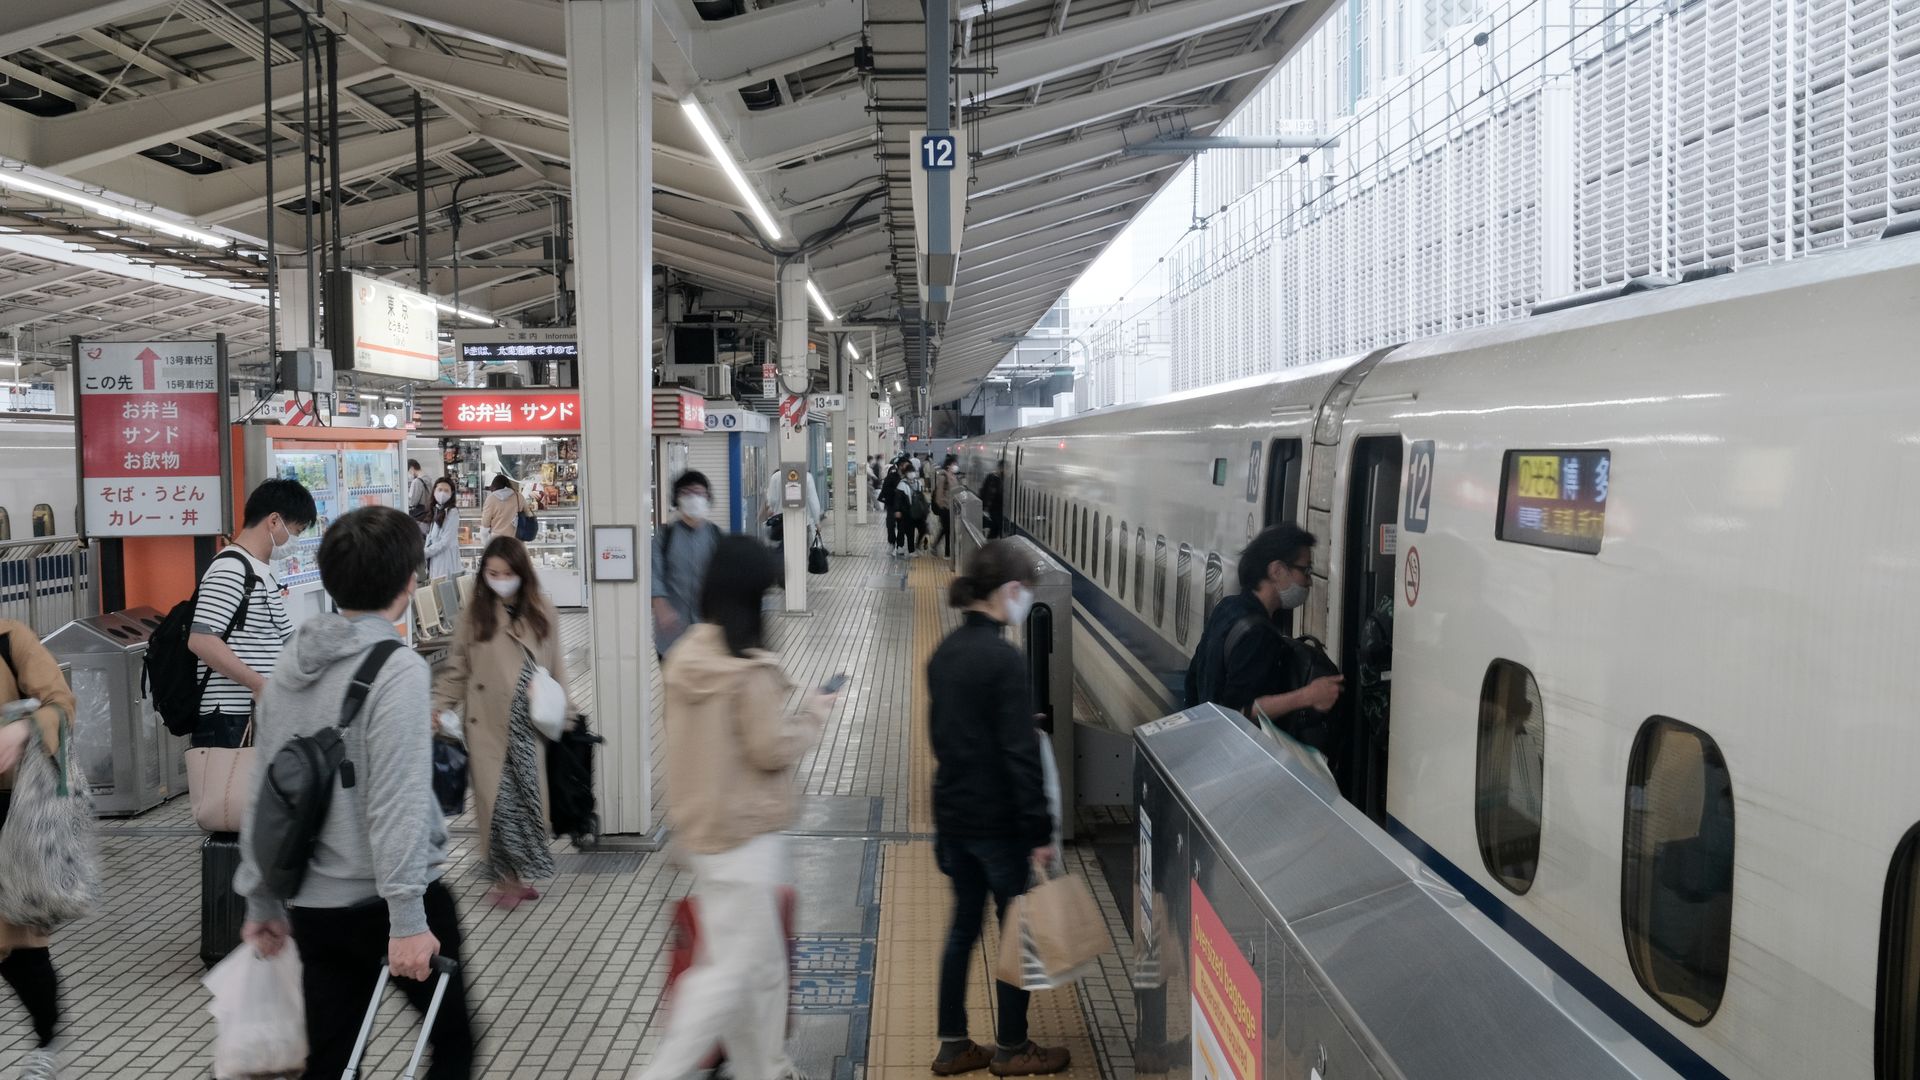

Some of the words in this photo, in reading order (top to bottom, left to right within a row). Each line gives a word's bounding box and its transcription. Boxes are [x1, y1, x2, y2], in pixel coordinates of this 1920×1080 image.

[924, 139, 953, 167] 12
[165, 355, 213, 366] 13号車付近
[86, 374, 133, 390] この先
[167, 379, 215, 390] 15号車付近
[122, 400, 179, 419] お弁当
[457, 402, 512, 422] お弁当
[520, 402, 575, 421] サンド
[122, 425, 179, 444] サンド
[124, 451, 180, 470] お飲物
[1249, 449, 1261, 495] 13
[100, 485, 205, 502] そば・うどん
[1409, 452, 1431, 521] 12
[109, 509, 199, 526] カレー・丼
[1195, 914, 1224, 982] Oversized
[1225, 965, 1256, 1041] baggage
